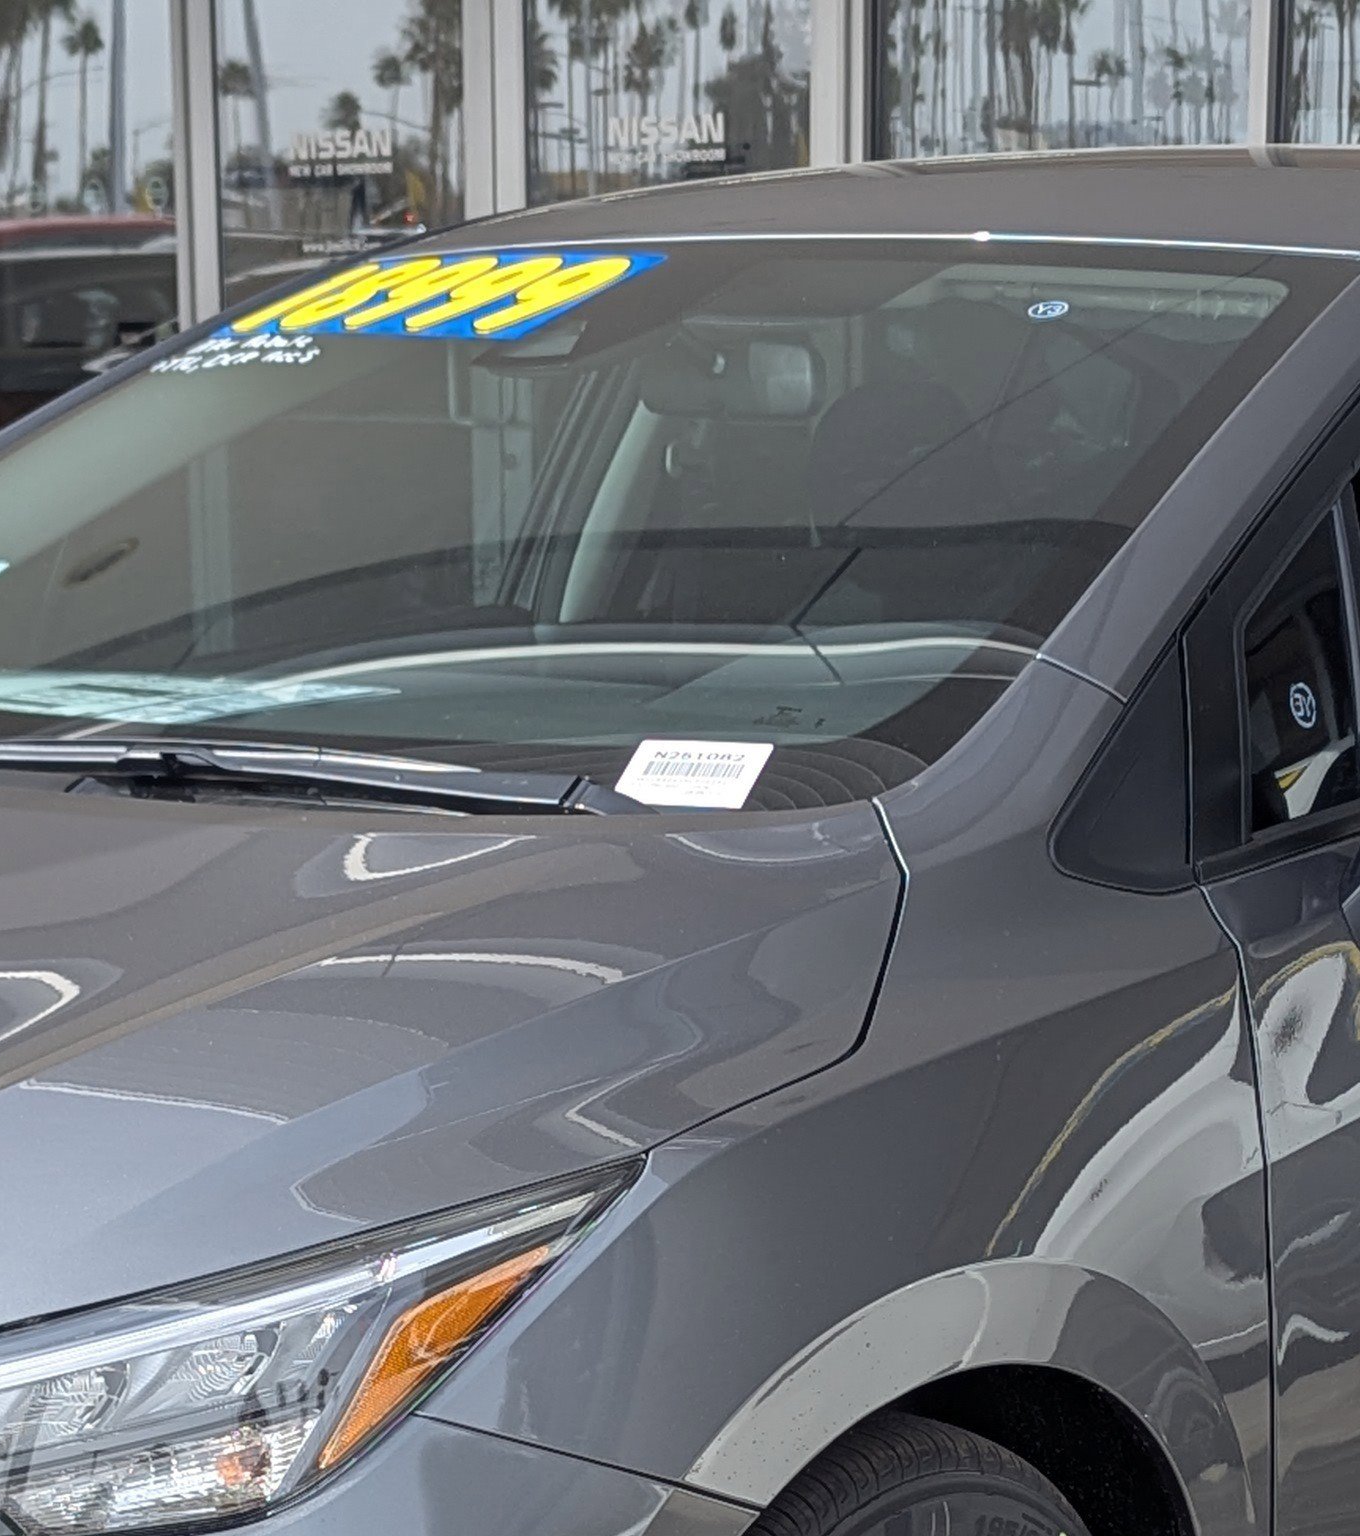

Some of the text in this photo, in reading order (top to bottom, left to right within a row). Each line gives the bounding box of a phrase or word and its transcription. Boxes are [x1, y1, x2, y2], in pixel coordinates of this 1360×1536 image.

[288, 129, 392, 160] NISSAN
[608, 112, 724, 147] NISSAN
[231, 255, 631, 334] 18999
